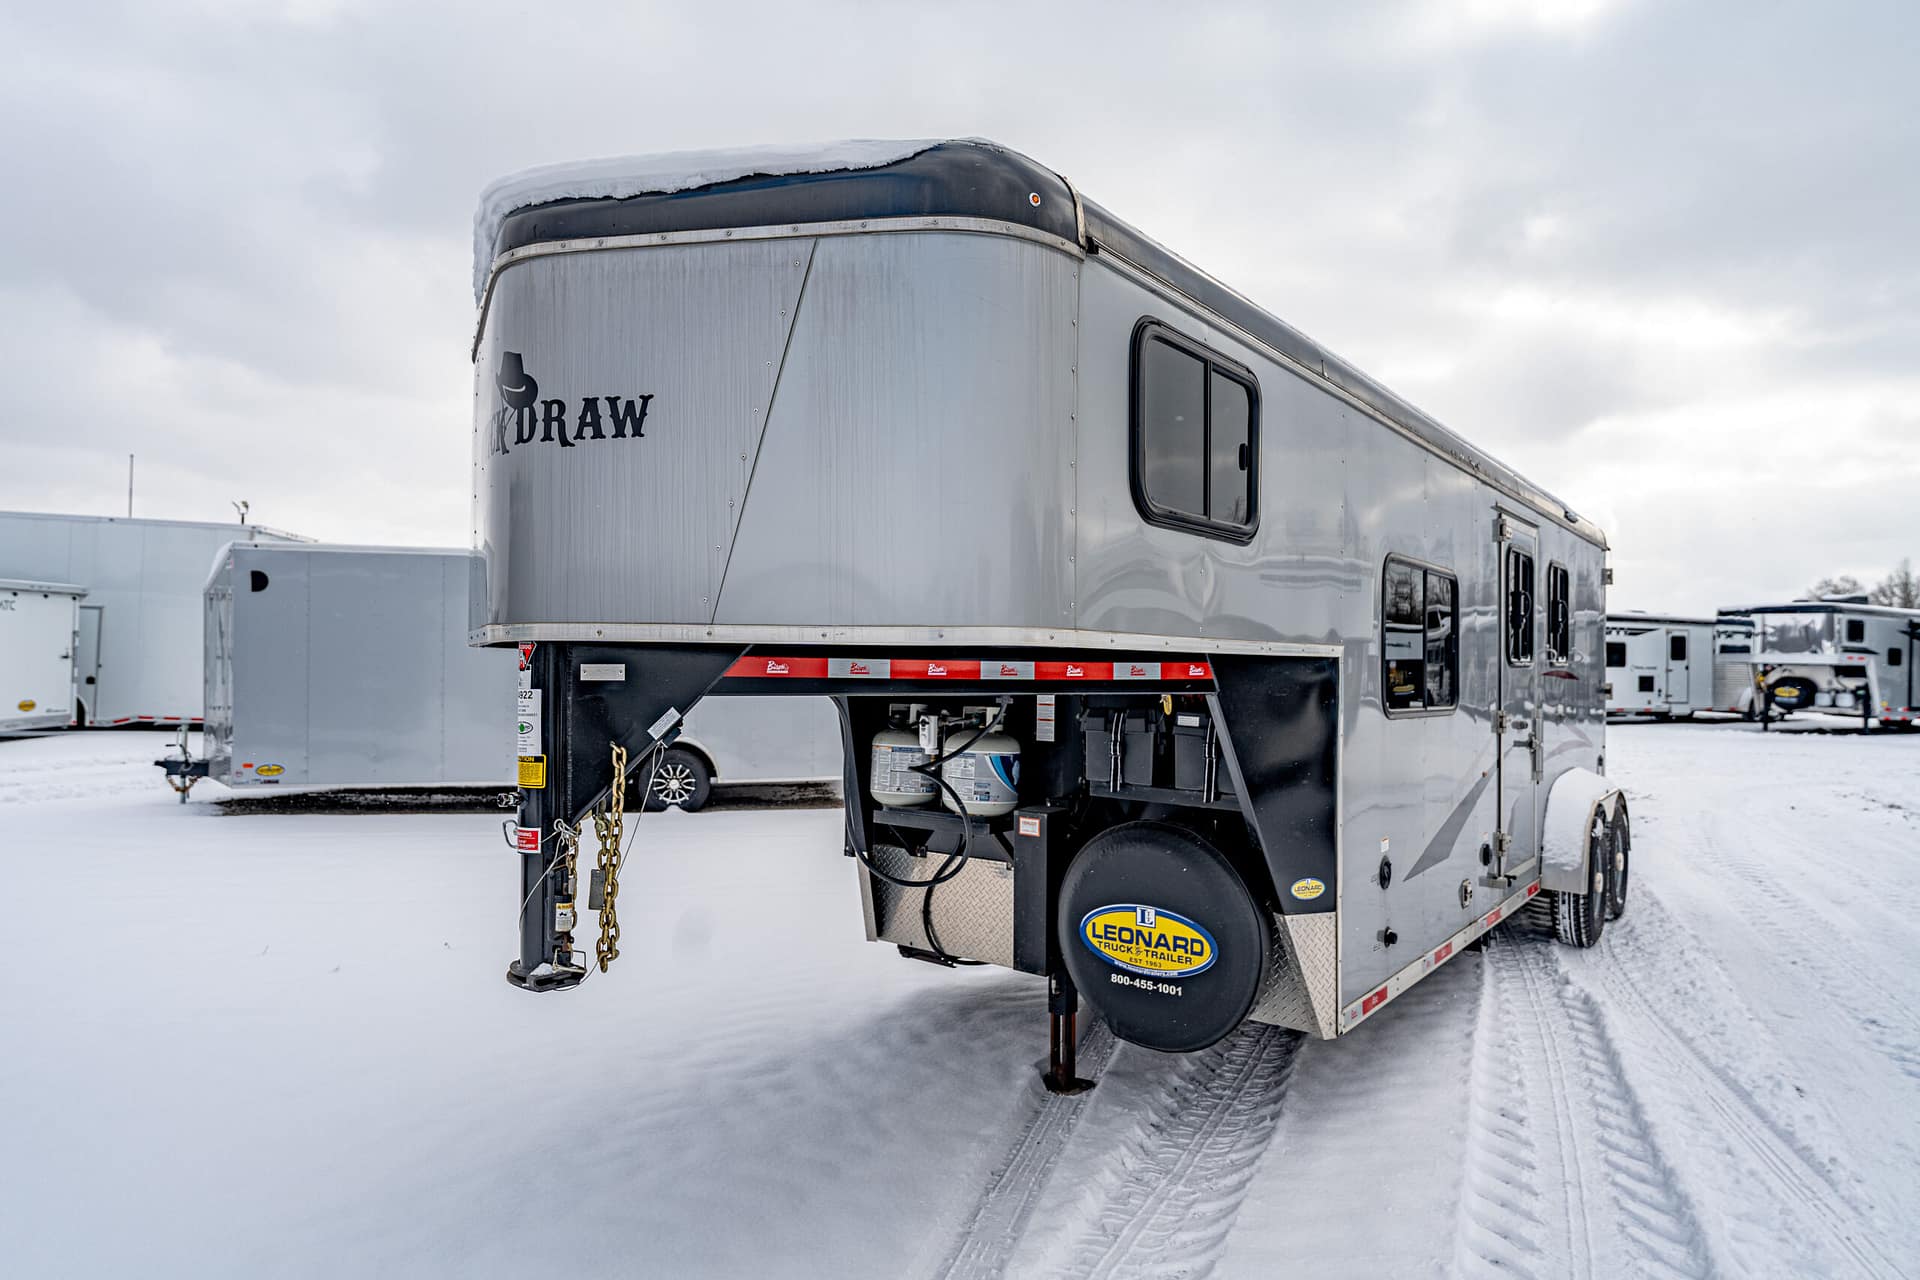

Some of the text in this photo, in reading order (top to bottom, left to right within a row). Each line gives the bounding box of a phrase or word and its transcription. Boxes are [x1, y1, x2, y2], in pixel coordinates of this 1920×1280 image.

[514, 394, 654, 448] DRAW
[1091, 921, 1204, 957] LEONARD
[1097, 940, 1133, 954] TRUCK
[1143, 949, 1193, 965] TRAILER
[1111, 973, 1182, 996] 800-455-1001
